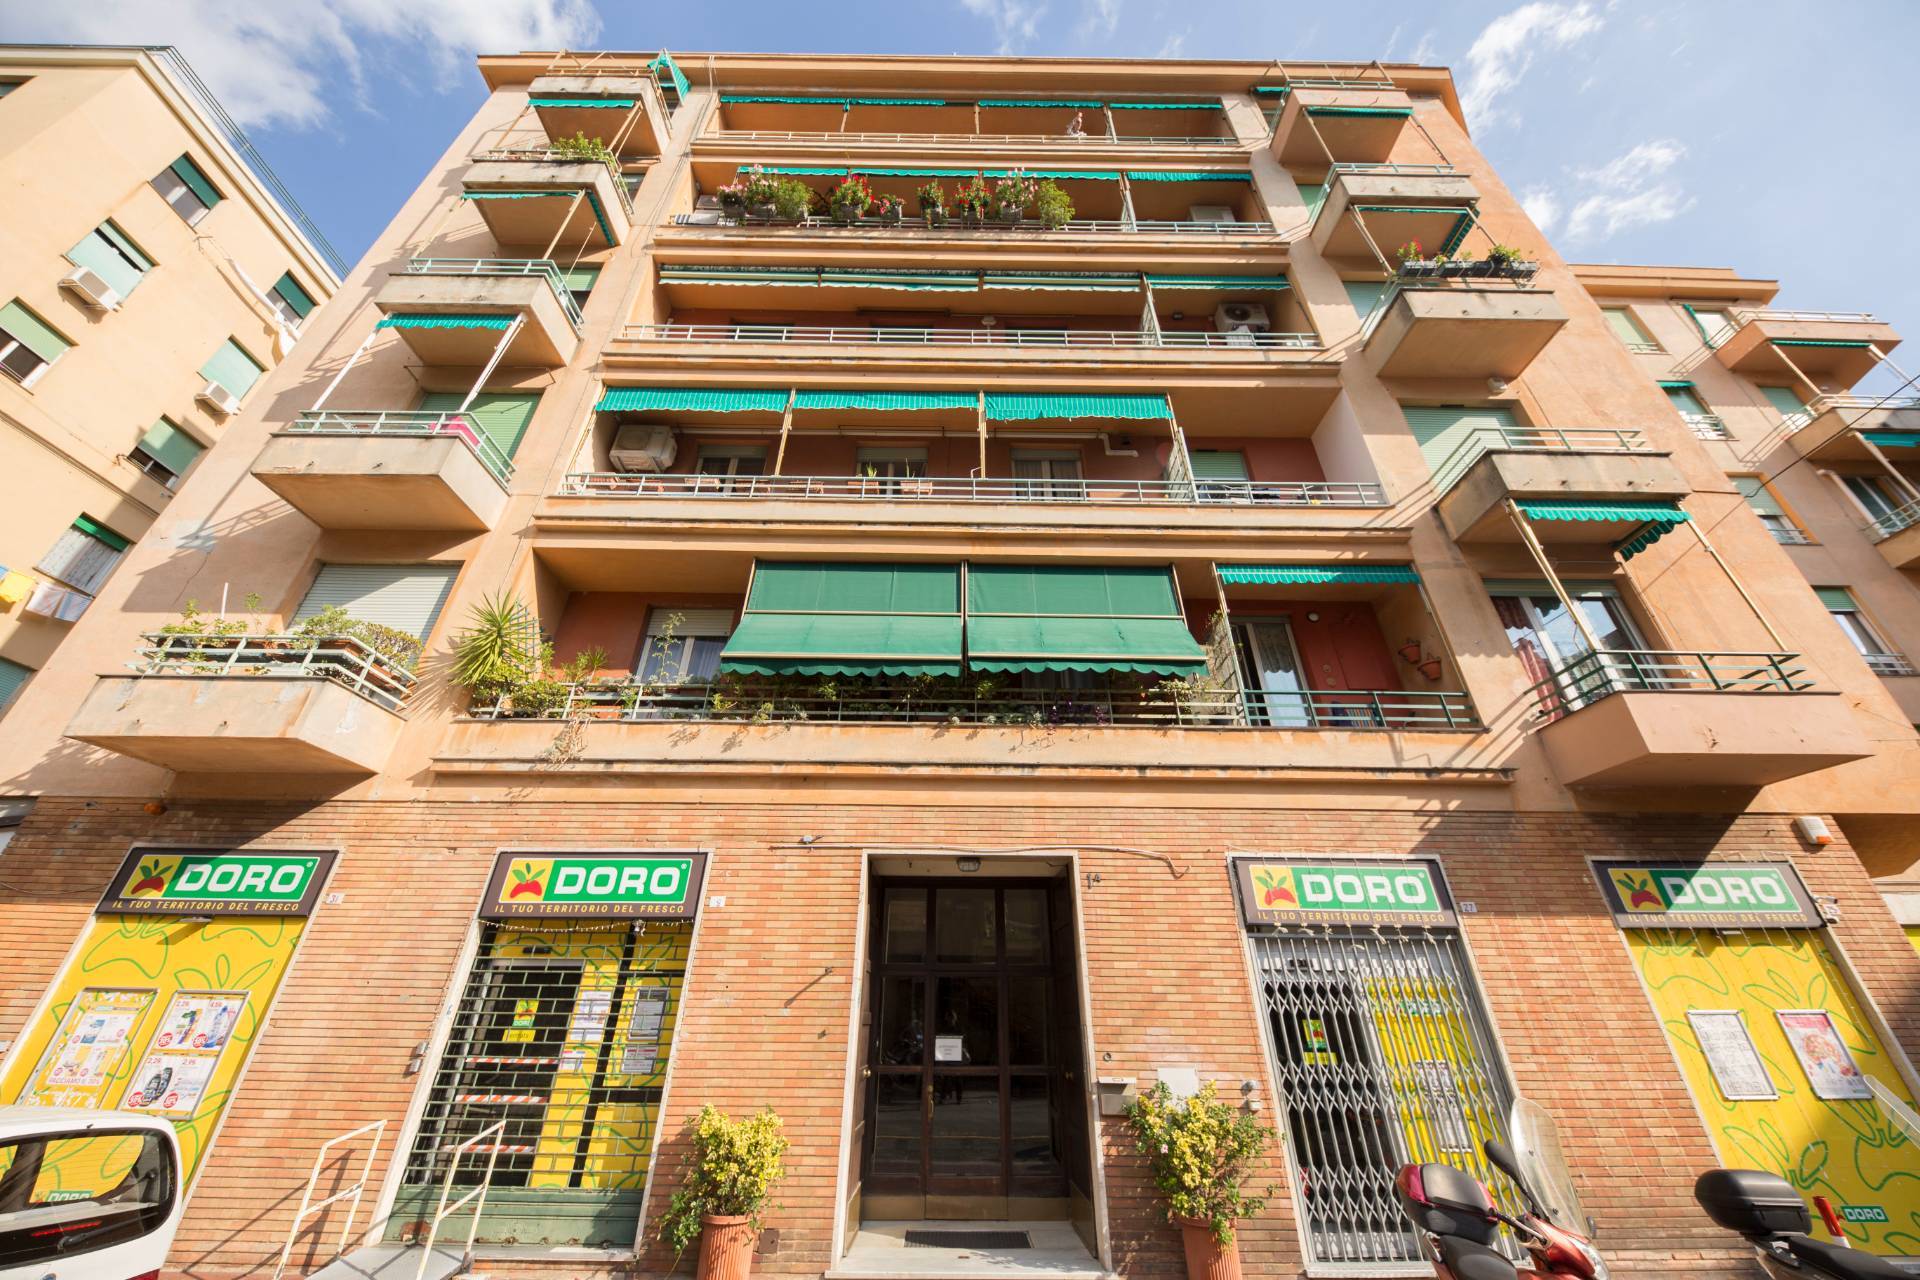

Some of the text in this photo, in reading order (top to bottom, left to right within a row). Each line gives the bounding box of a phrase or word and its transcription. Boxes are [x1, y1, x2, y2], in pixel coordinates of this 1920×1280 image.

[174, 863, 305, 893] DORO
[554, 866, 680, 895] DORO
[1301, 874, 1427, 904] DORO
[1660, 876, 1786, 904] DORO
[112, 901, 300, 911] IL TUO TERRITORIO DEL FRESCO
[494, 904, 685, 913] IL TUO TERRITORIO DEL FRESCO
[1257, 911, 1445, 922] IL TUO TERRITORIO DEL FRESCO
[1628, 914, 1809, 923] IL TUO TERRITORIO DEL FRESCO
[1843, 1208, 1886, 1220] DORO
